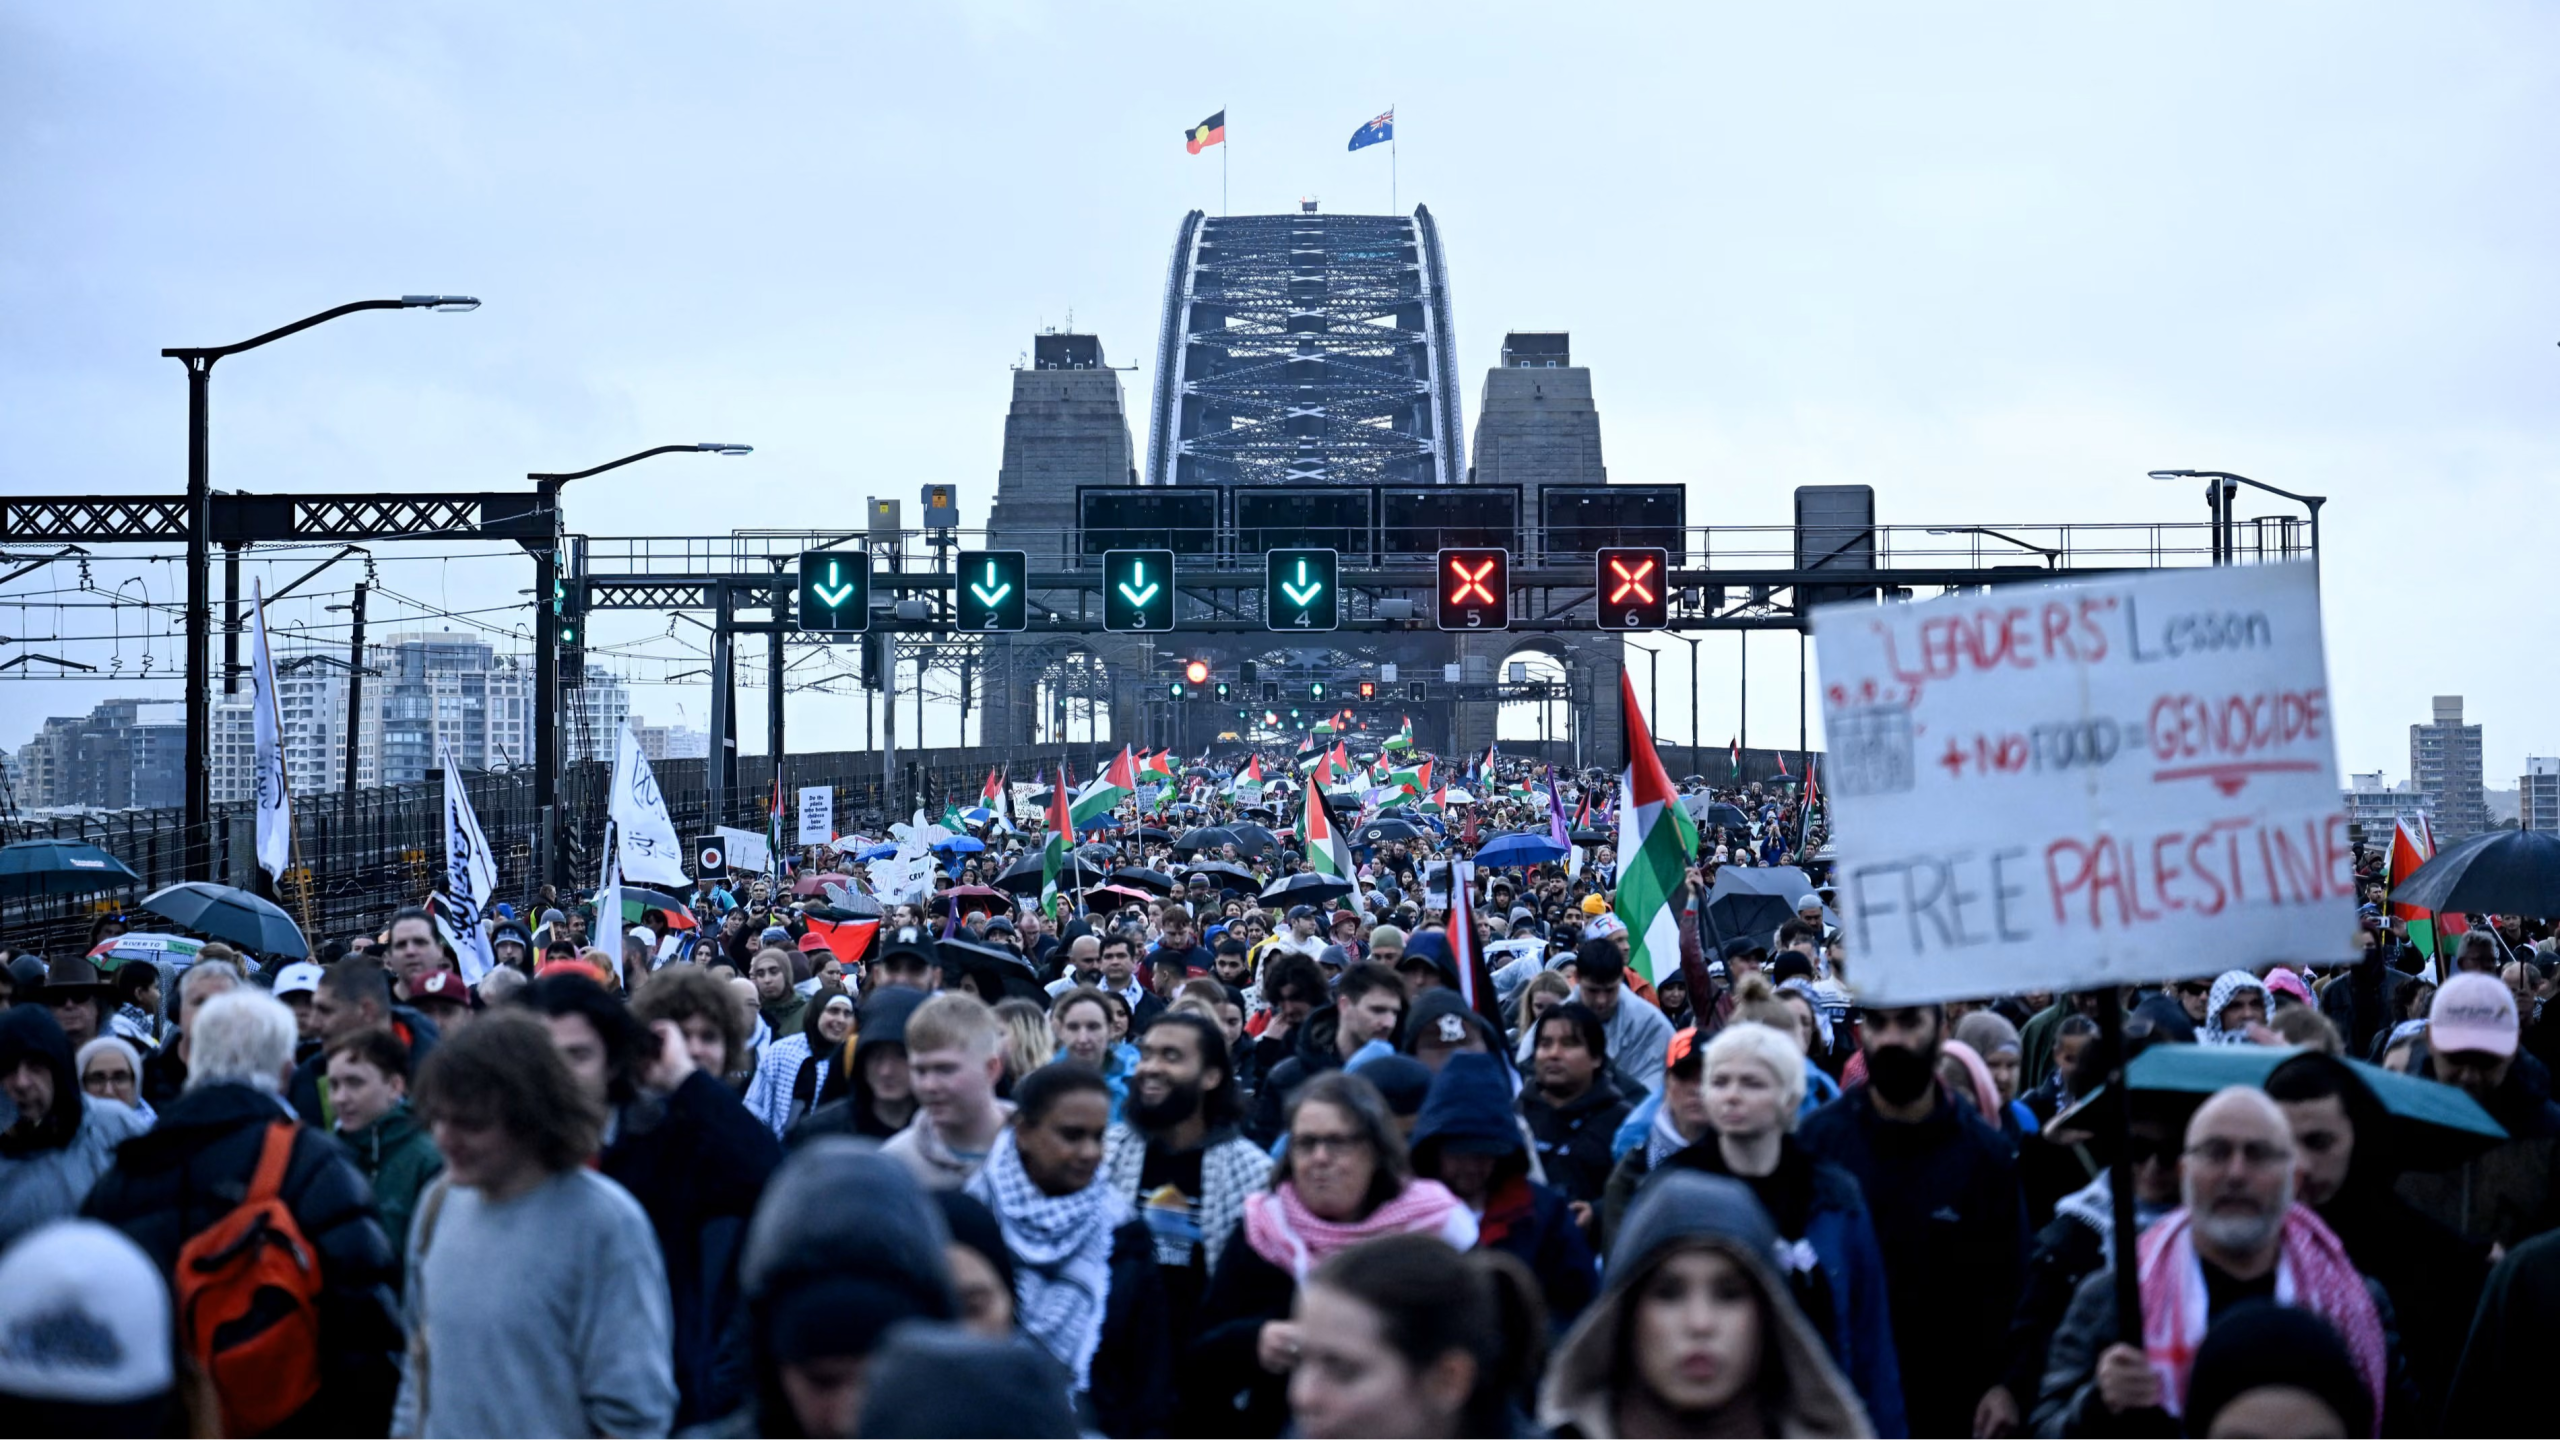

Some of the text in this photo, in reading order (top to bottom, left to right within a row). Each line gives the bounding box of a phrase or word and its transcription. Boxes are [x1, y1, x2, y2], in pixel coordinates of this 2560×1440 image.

[830, 611, 837, 629] 1
[984, 611, 998, 629] 2
[1132, 610, 1147, 629] 3
[1294, 609, 1311, 628] 4
[1467, 609, 1481, 627] 5
[1625, 608, 1640, 627] 6
[2125, 595, 2273, 662] Lesson
[2148, 685, 2326, 762] GENOCIDE
[1850, 814, 2355, 955] FREE PALESTINE
